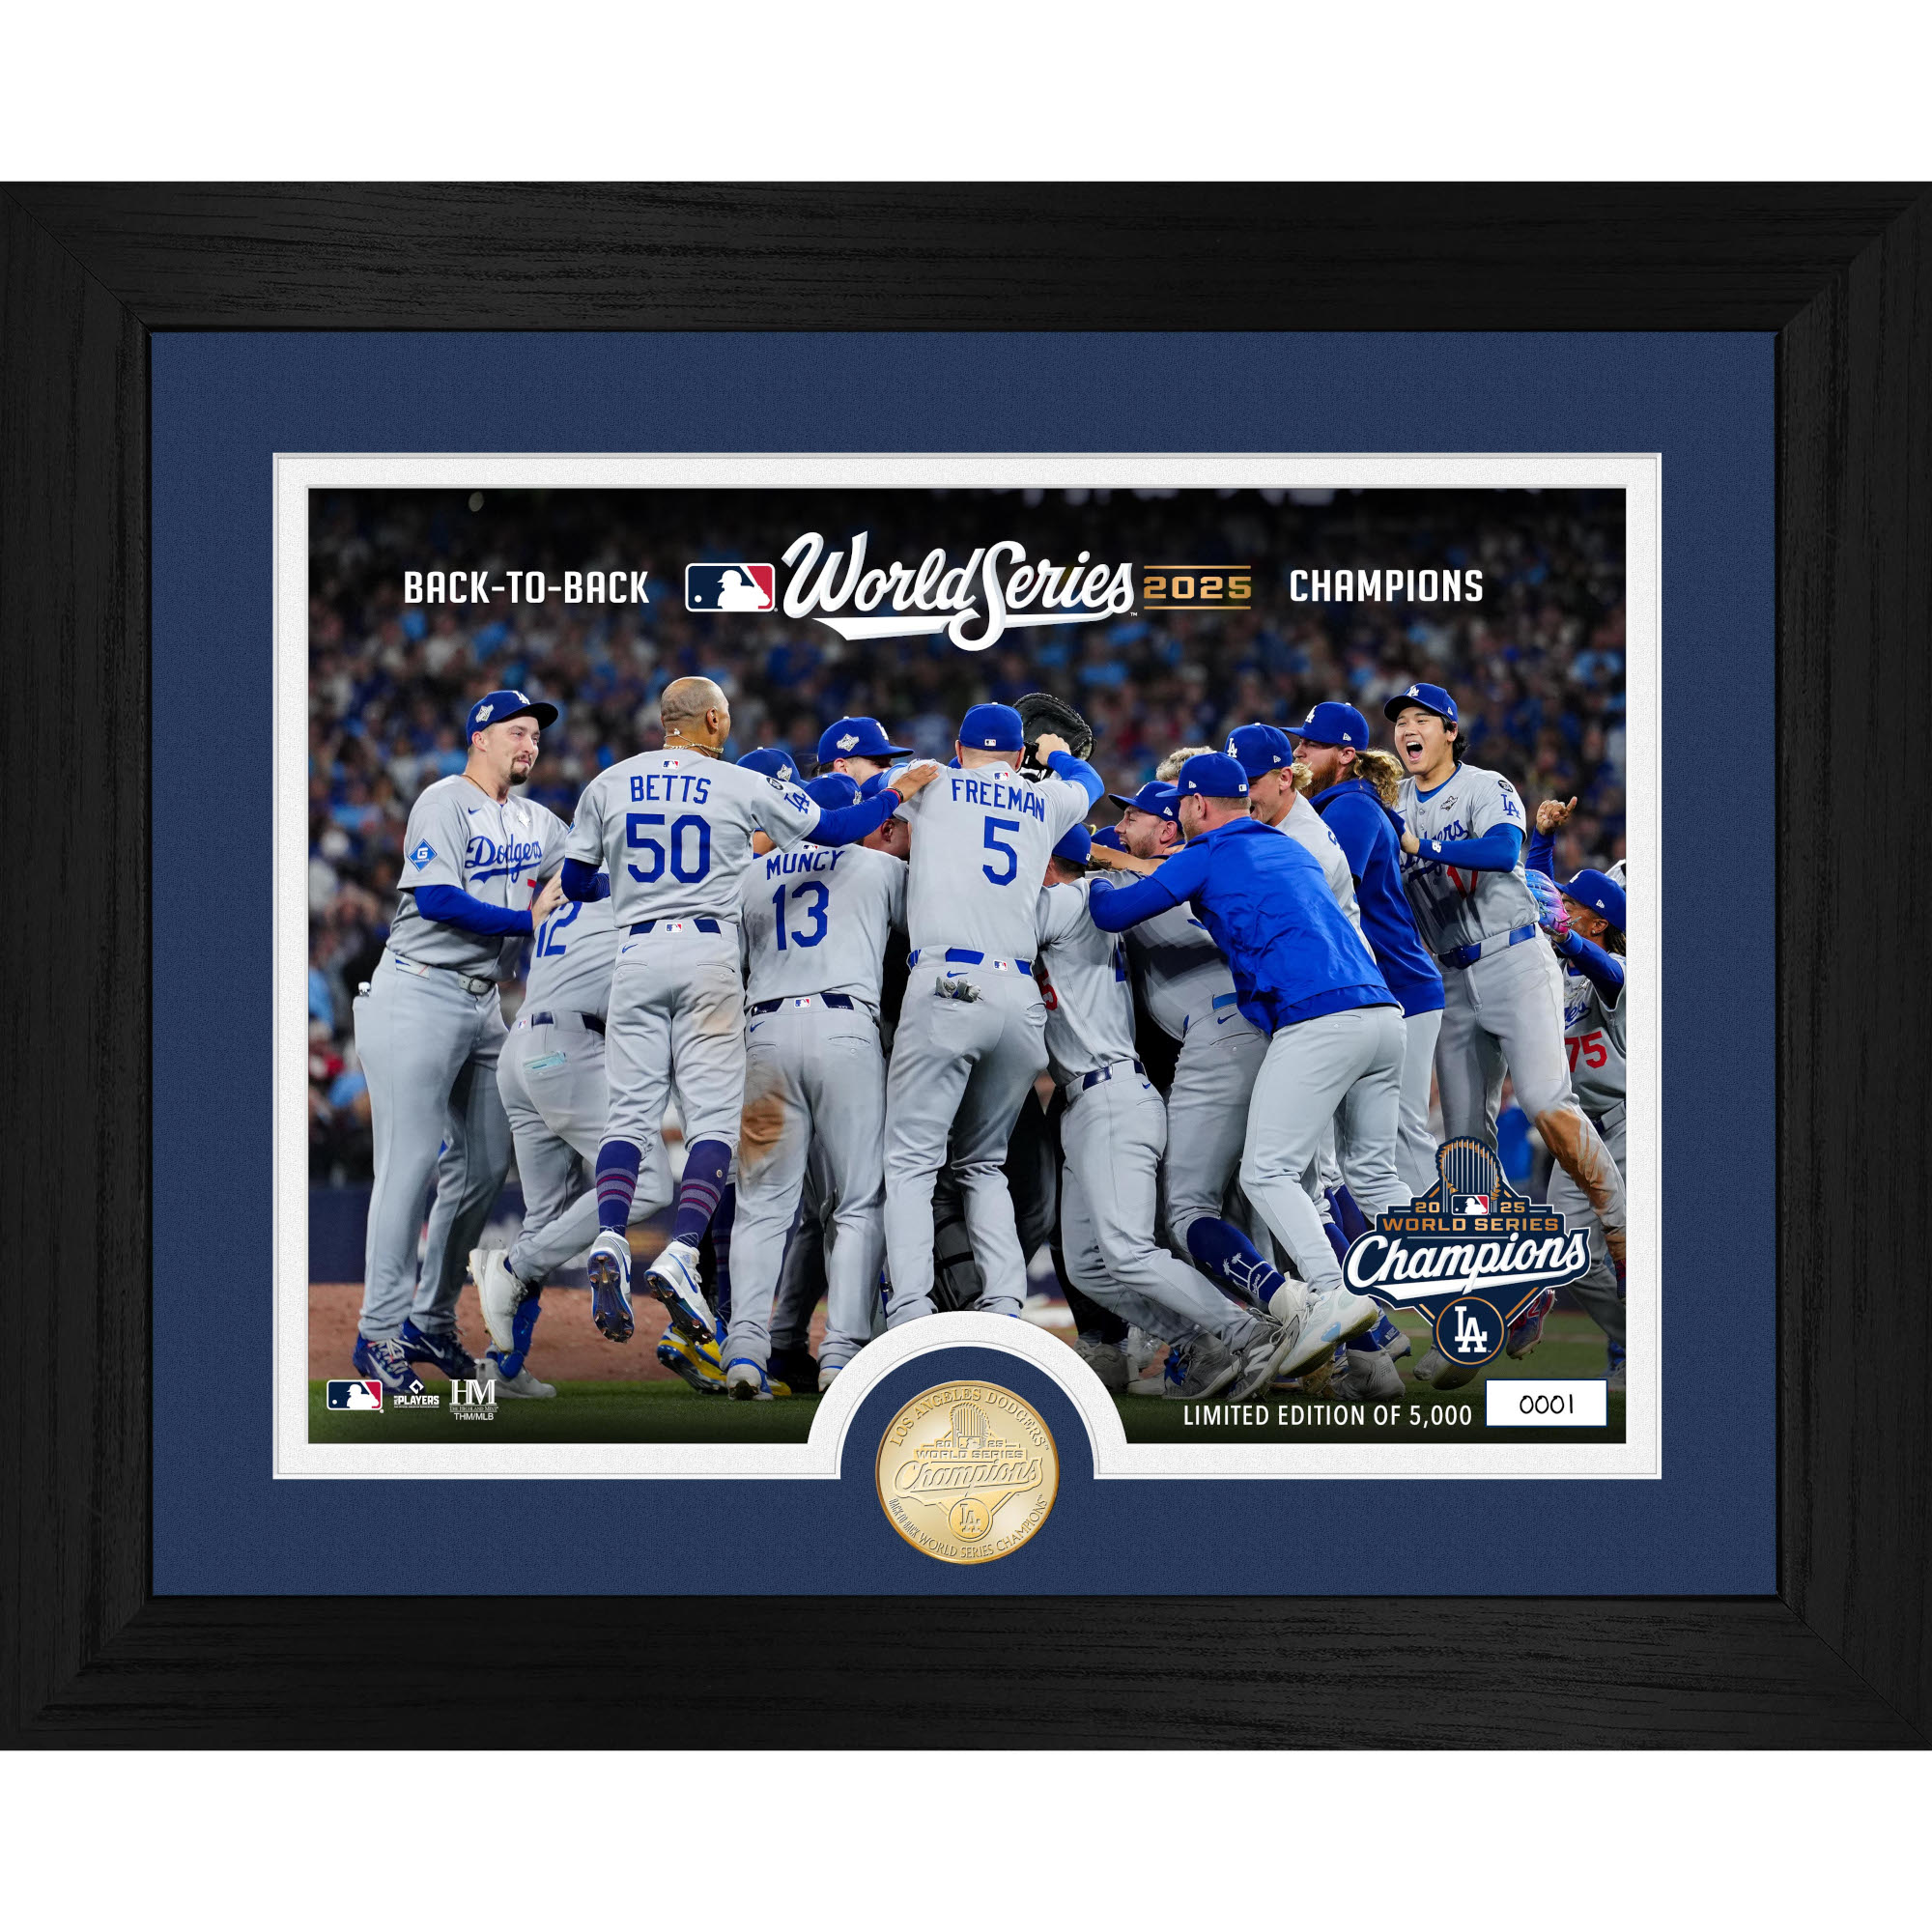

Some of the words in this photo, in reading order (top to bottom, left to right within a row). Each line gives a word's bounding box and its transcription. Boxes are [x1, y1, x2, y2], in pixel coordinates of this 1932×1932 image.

[404, 571, 650, 604] BACK-TO-BACK
[781, 530, 986, 619] World
[948, 540, 1135, 652] Series
[1143, 576, 1252, 599] 2025
[1290, 569, 1483, 602] CHAMPIONS
[630, 774, 711, 805] BETTS
[951, 778, 1045, 823] FREEMAN
[1500, 793, 1521, 820] LA
[416, 847, 429, 860] G
[465, 834, 543, 884] Dodgers
[626, 812, 711, 884] 50
[766, 849, 846, 880] MUNCY
[981, 815, 1020, 886] 5
[536, 900, 582, 958] 12
[773, 880, 830, 952] 13
[1564, 1030, 1608, 1073] 75
[1415, 1202, 1440, 1213] 20
[1500, 1202, 1526, 1213] 25
[1382, 1218, 1466, 1232] WORLD
[1474, 1218, 1559, 1232] SERIES
[1347, 1232, 1585, 1295] Champions
[1454, 1305, 1488, 1353] LA
[398, 1395, 440, 1406] PLAYERS
[449, 1378, 497, 1406] HM
[1520, 1394, 1574, 1414] 0001
[454, 1412, 495, 1421] THM/MLB
[890, 1416, 915, 1447] LOS
[914, 1388, 981, 1420] ANGELES
[985, 1391, 1046, 1447] DODGERS
[1183, 1405, 1269, 1425] LIMITED
[1278, 1405, 1366, 1425] EDITION
[1374, 1405, 1402, 1425] OF
[1409, 1405, 1472, 1428] 5,000
[916, 1450, 967, 1459] WORLD
[971, 1450, 1024, 1459] SERIES
[895, 1458, 1043, 1494] Champions
[918, 1532, 957, 1558] WORLD
[960, 1544, 994, 1558] SERIES
[996, 1499, 1048, 1551] CHAMPIONS
[959, 1503, 982, 1533] LA
